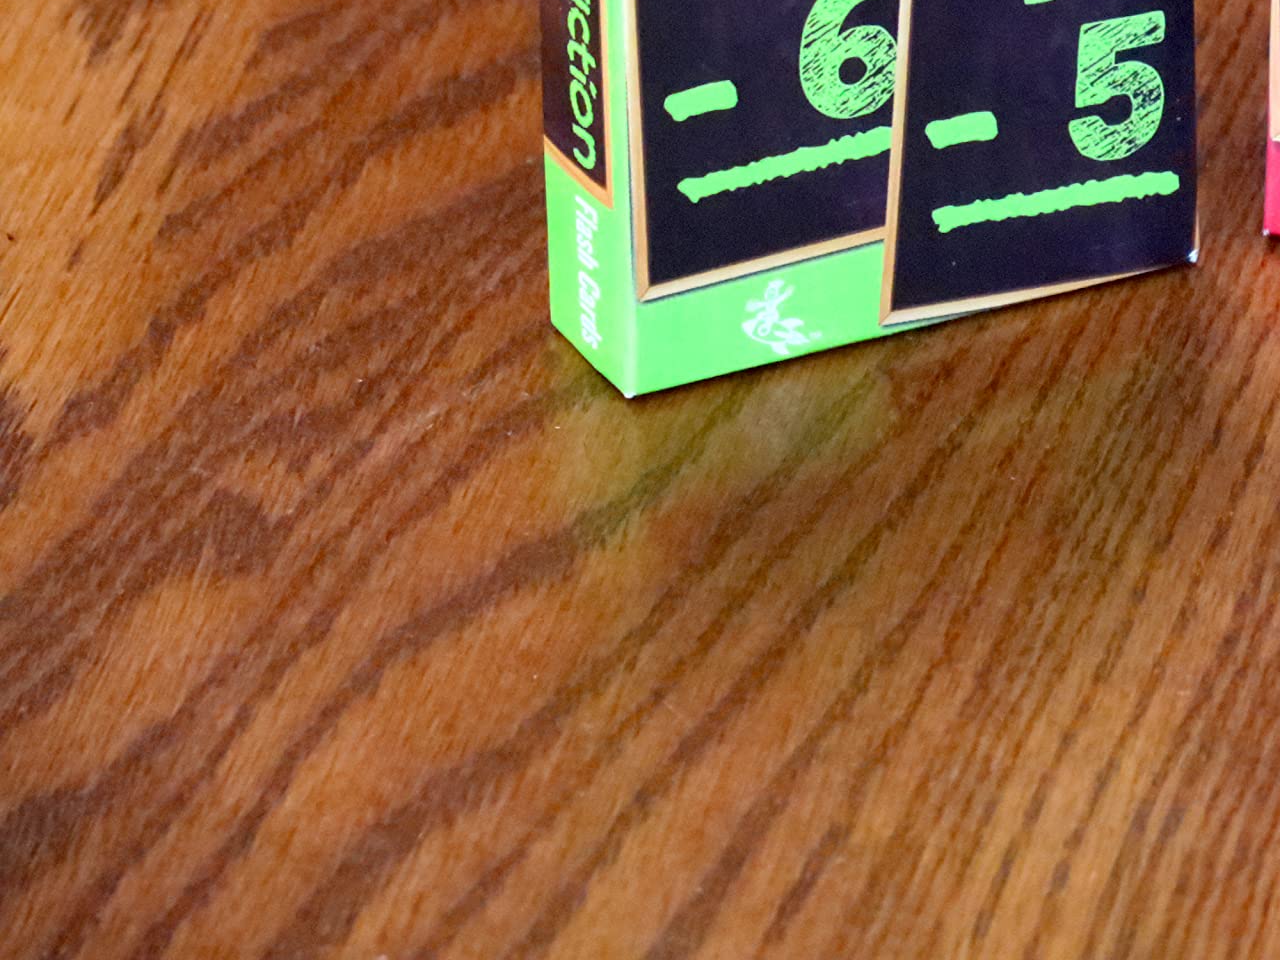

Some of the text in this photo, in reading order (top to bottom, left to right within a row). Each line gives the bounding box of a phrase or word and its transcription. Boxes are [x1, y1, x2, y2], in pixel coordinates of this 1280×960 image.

[1067, 10, 1167, 162] 5
[574, 194, 603, 351] Flash Cards
